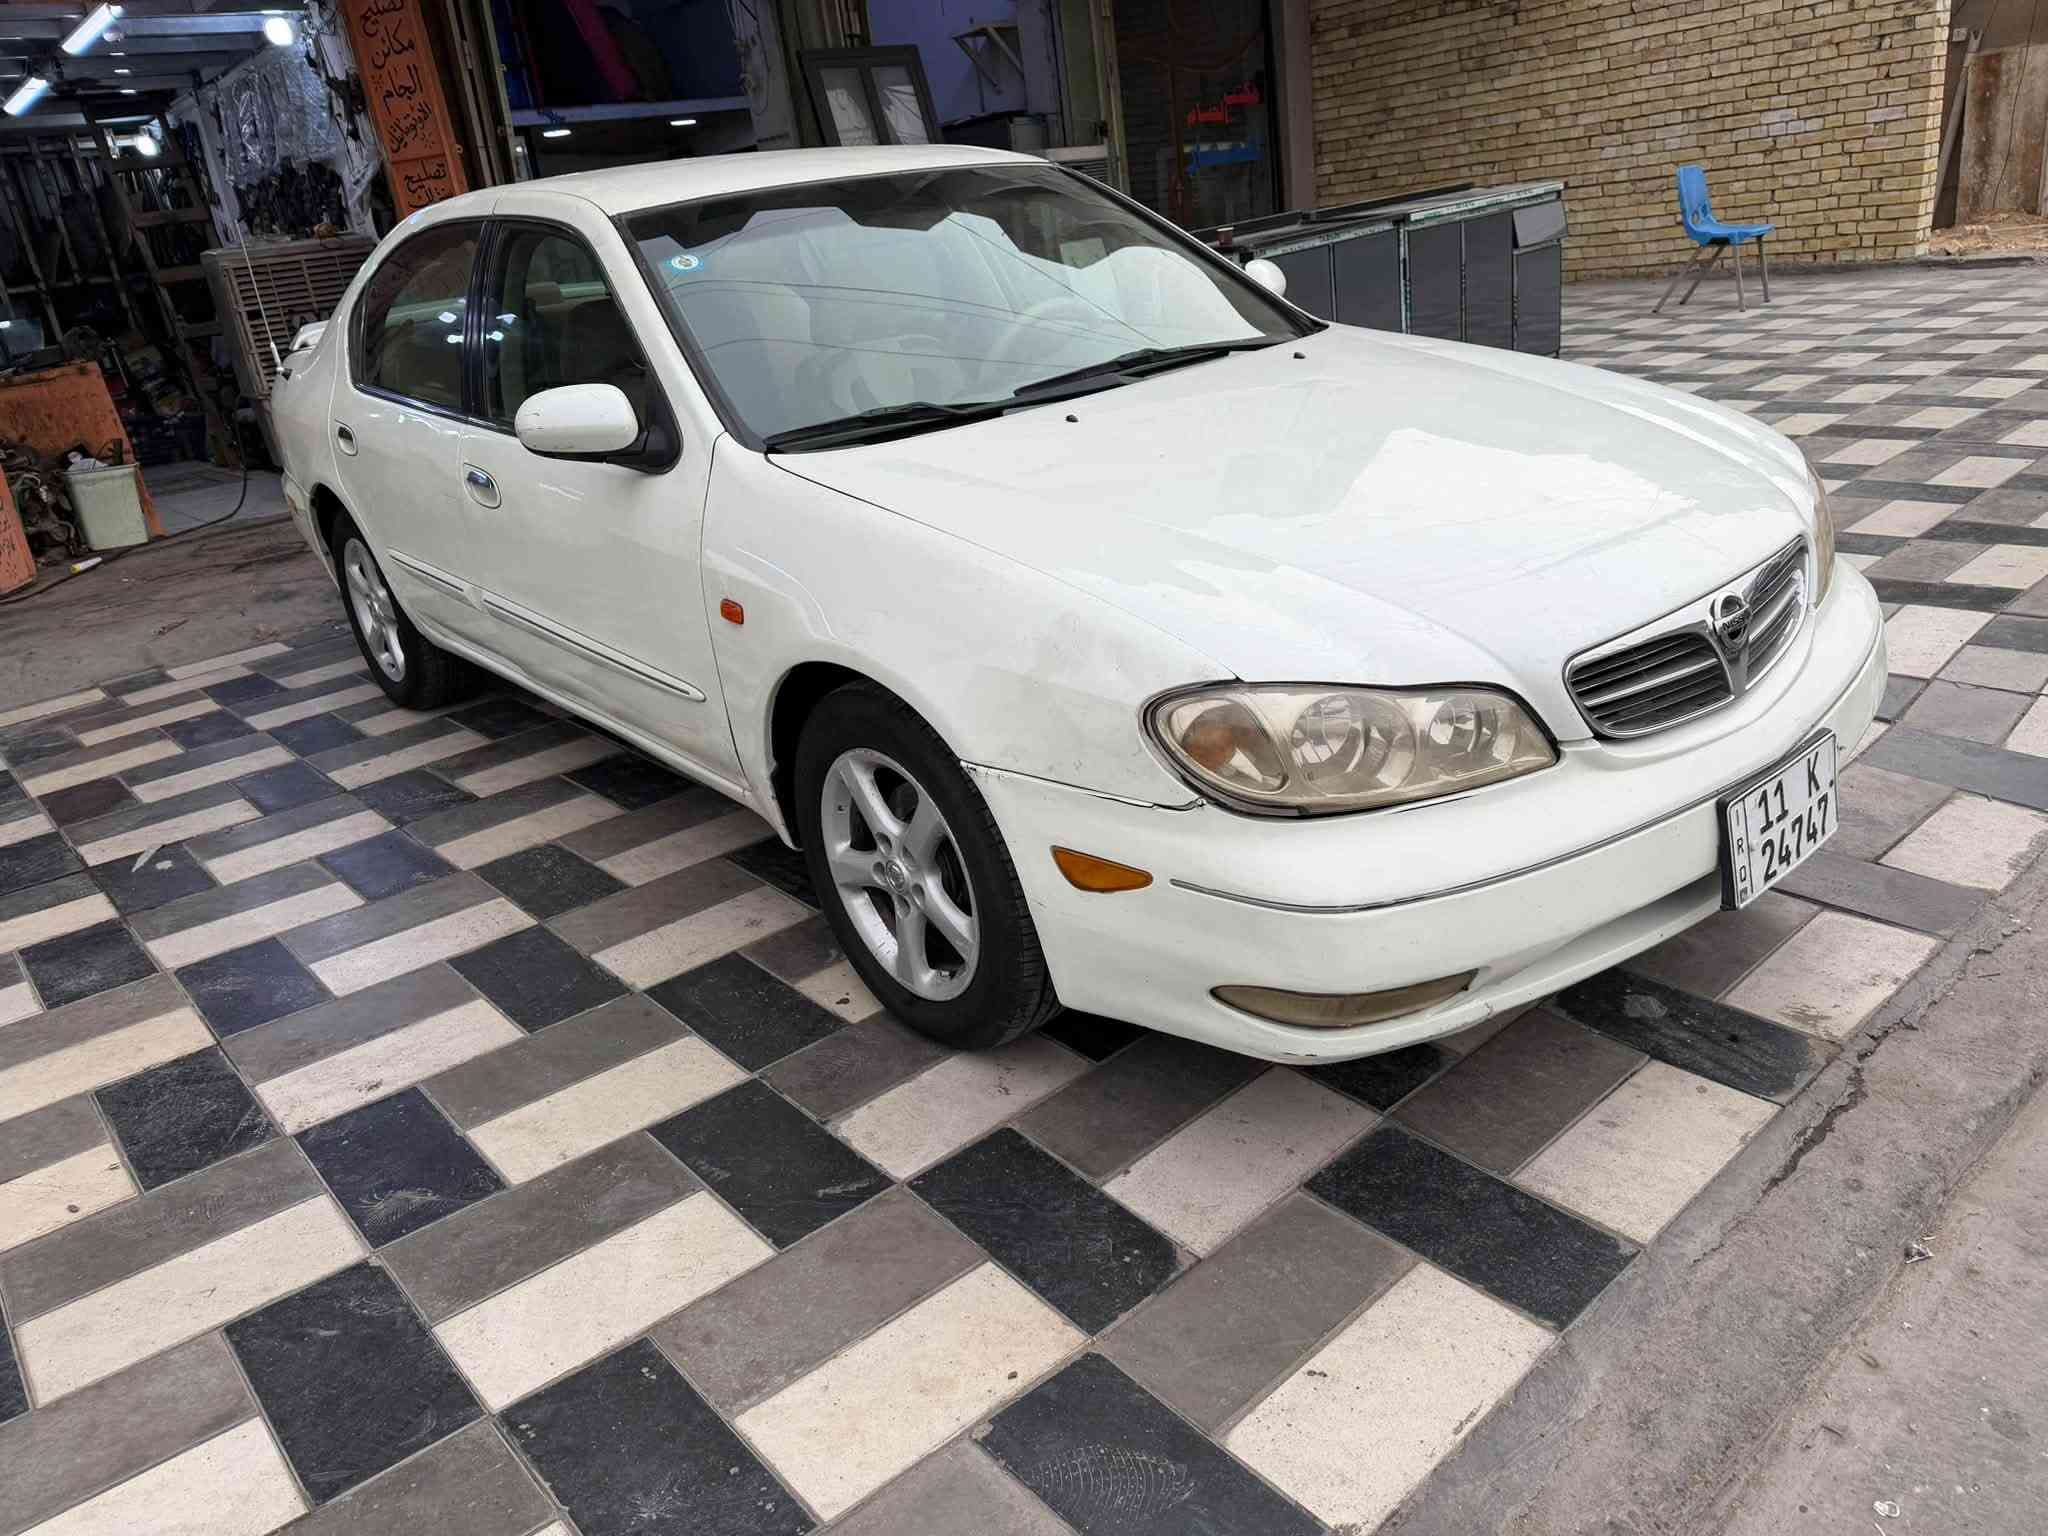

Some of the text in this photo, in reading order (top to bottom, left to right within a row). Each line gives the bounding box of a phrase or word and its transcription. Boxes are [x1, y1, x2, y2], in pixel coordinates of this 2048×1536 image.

[1758, 751, 1820, 835] 11 K
[1761, 791, 1829, 885] 24747
